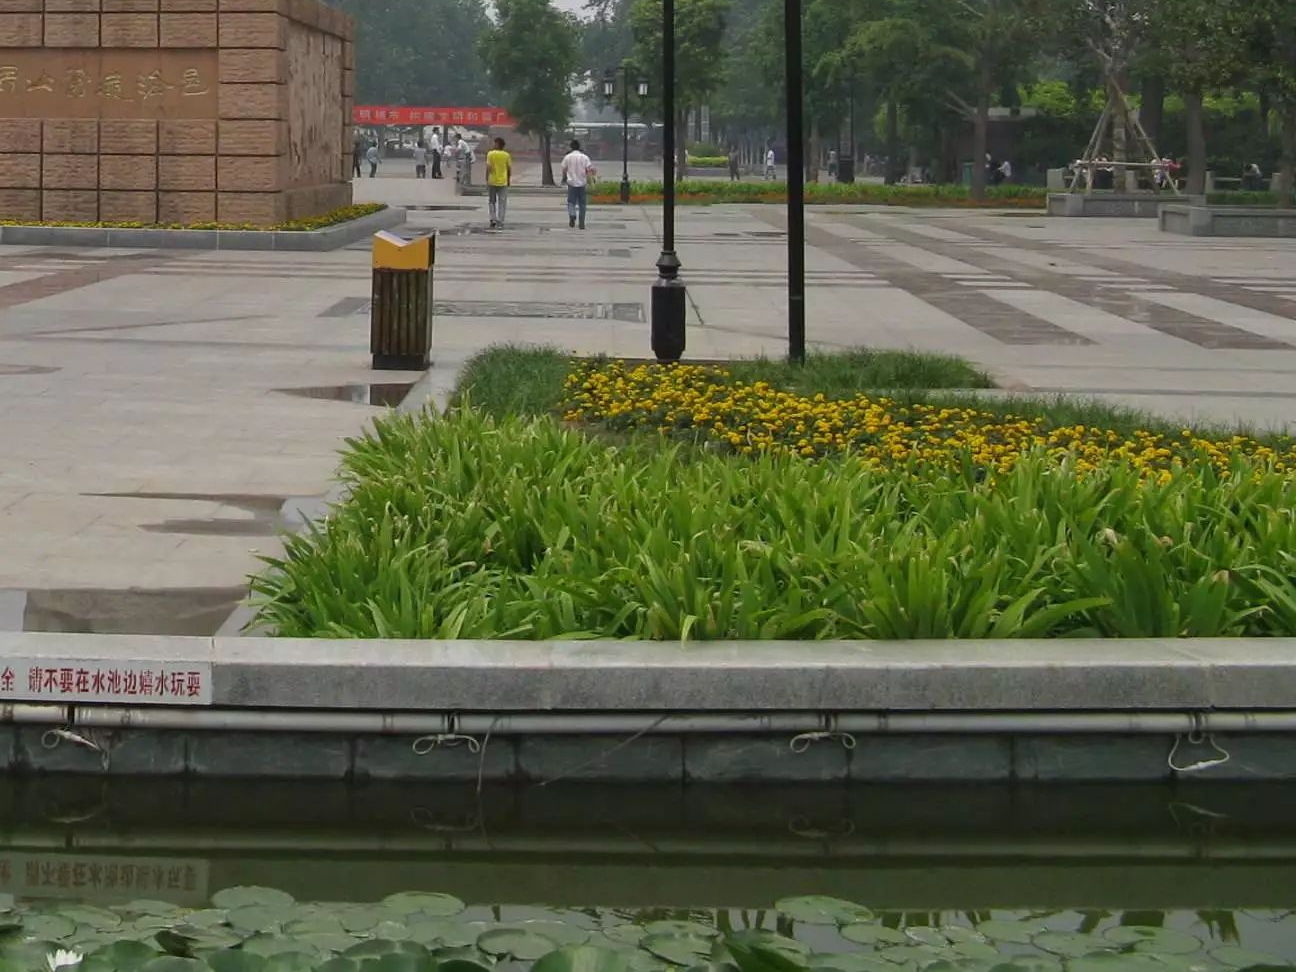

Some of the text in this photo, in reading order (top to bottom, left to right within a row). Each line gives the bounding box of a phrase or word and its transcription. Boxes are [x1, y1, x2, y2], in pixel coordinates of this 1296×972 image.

[28, 665, 201, 697] 请不要在水池边嬉水玩耍
